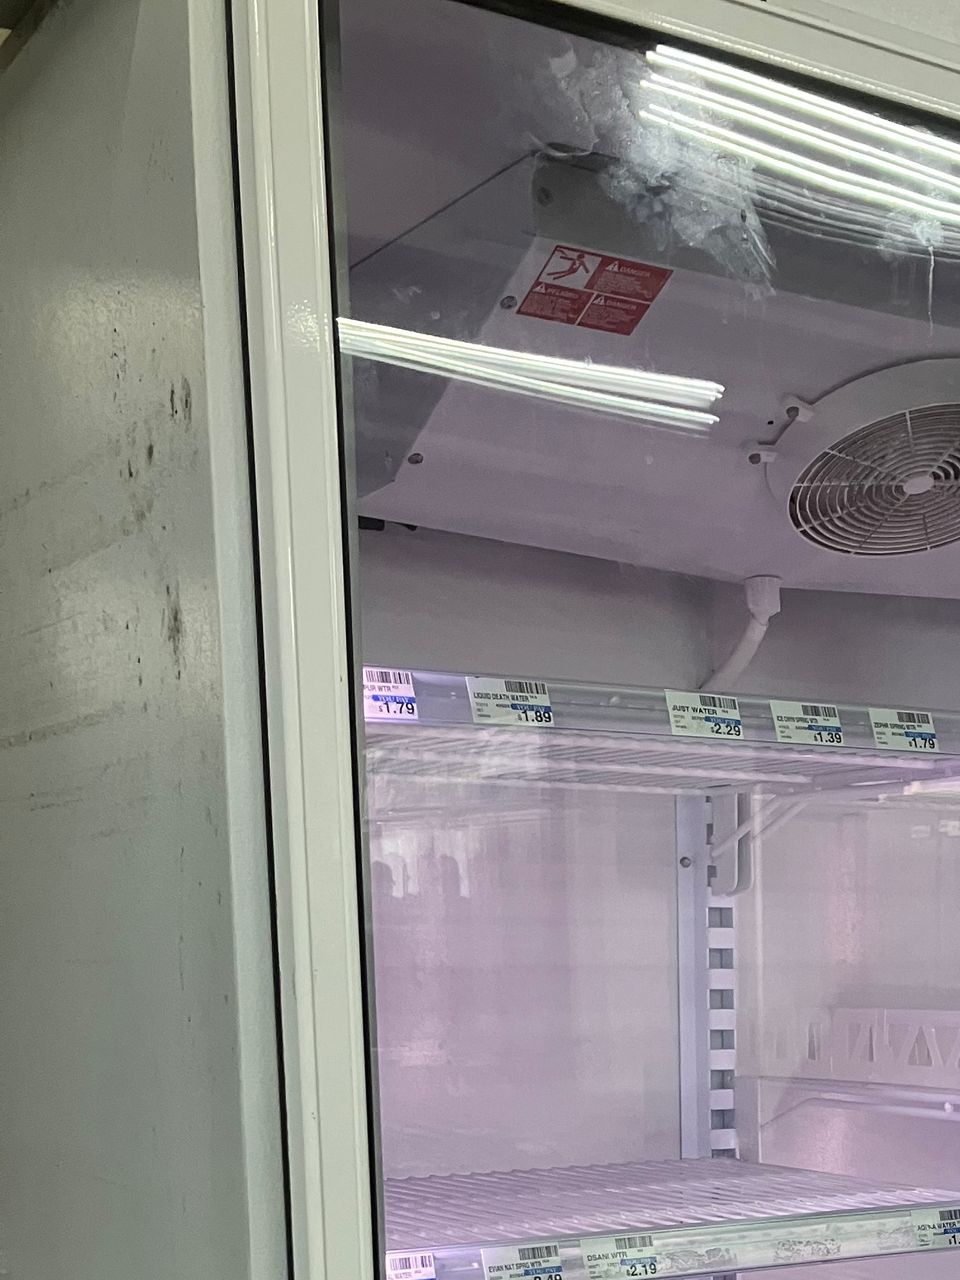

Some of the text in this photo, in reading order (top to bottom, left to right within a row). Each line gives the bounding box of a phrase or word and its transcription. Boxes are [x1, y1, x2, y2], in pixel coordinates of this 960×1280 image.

[473, 691, 529, 702] LIQUID DEATH WATER
[378, 701, 415, 716] $1.79
[672, 704, 718, 715] JUST WATER
[517, 710, 552, 723] $1.89
[710, 722, 741, 737] $2.29
[813, 731, 842, 744] $1.39
[908, 737, 935, 749] $1.79
[937, 1221, 957, 1230] WATER
[586, 1251, 628, 1262] DSANI WTR
[504, 1263, 515, 1271] NAT
[530, 1260, 542, 1268] WTR
[626, 1262, 657, 1277] $2.19
